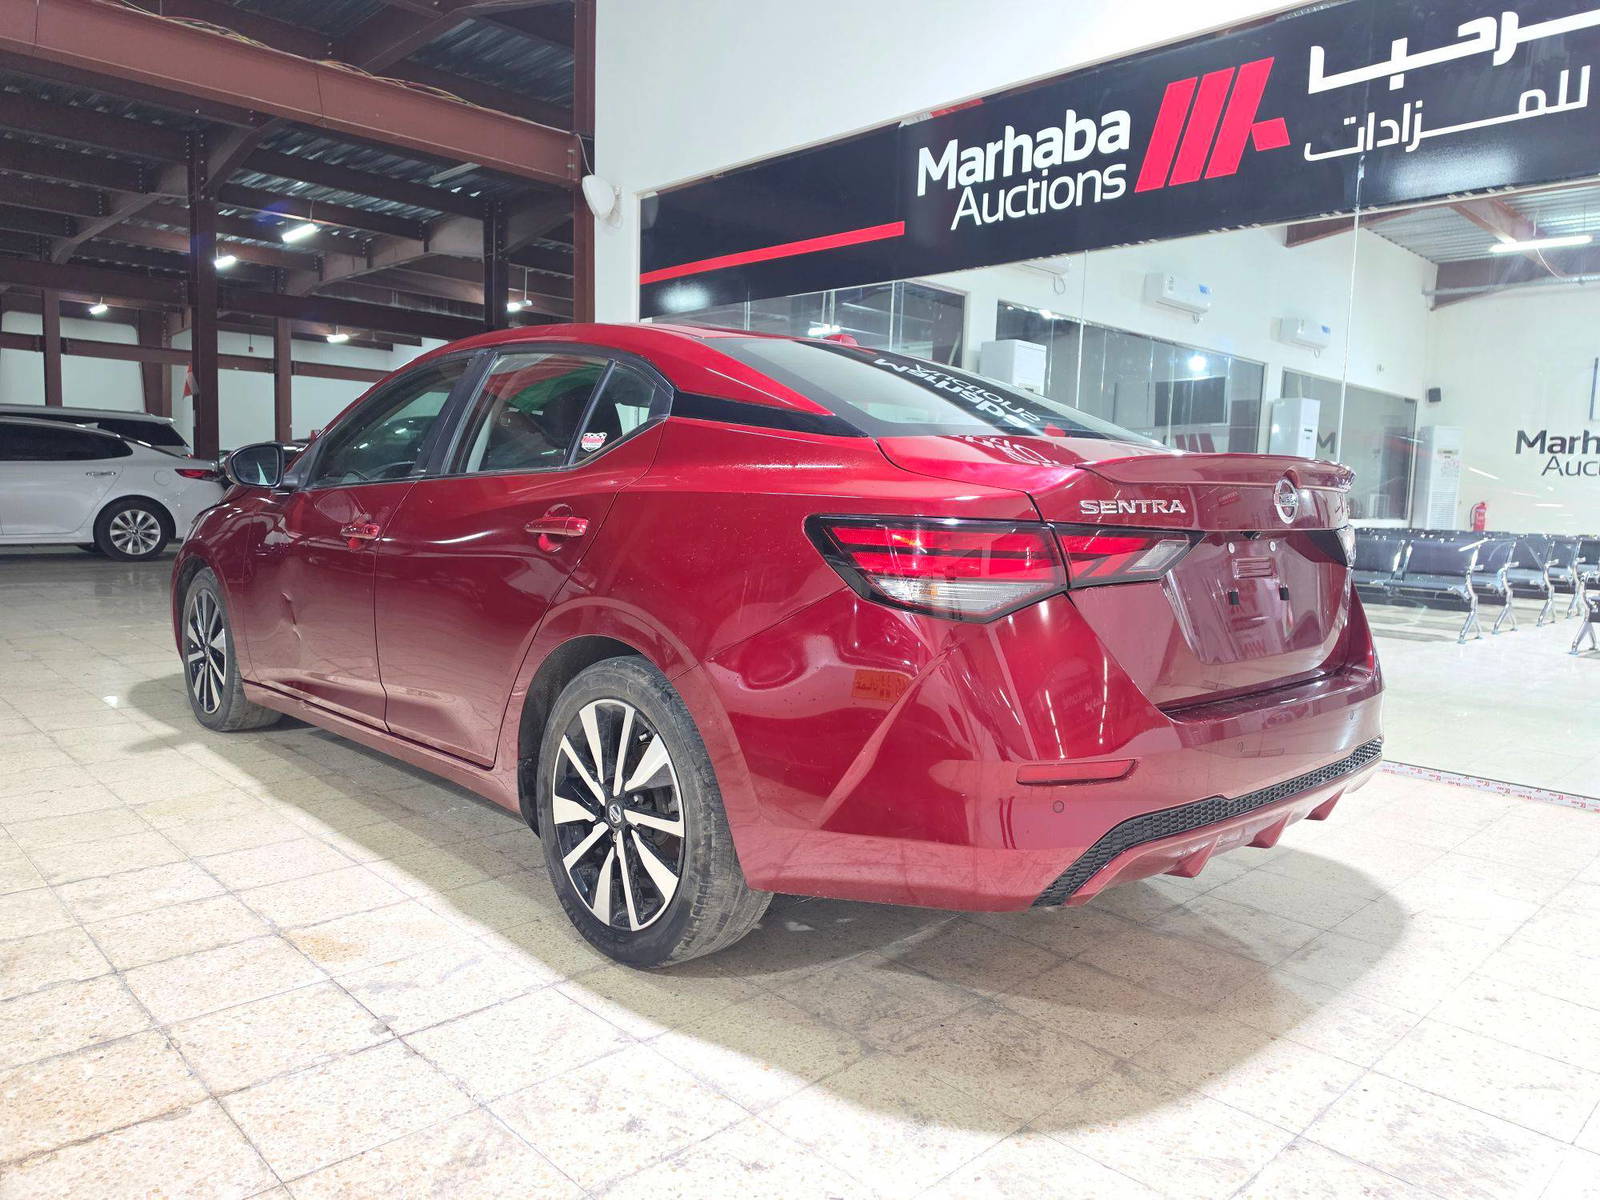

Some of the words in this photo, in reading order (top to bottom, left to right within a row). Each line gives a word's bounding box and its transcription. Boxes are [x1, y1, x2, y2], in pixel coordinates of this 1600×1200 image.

[1308, 9, 1600, 95] رحبا
[917, 109, 1131, 197] Marhaba
[950, 163, 1127, 231] Auctions
[1515, 429, 1600, 455] Marh
[1541, 455, 1600, 476] Auc
[1080, 499, 1186, 514] SENTRA
